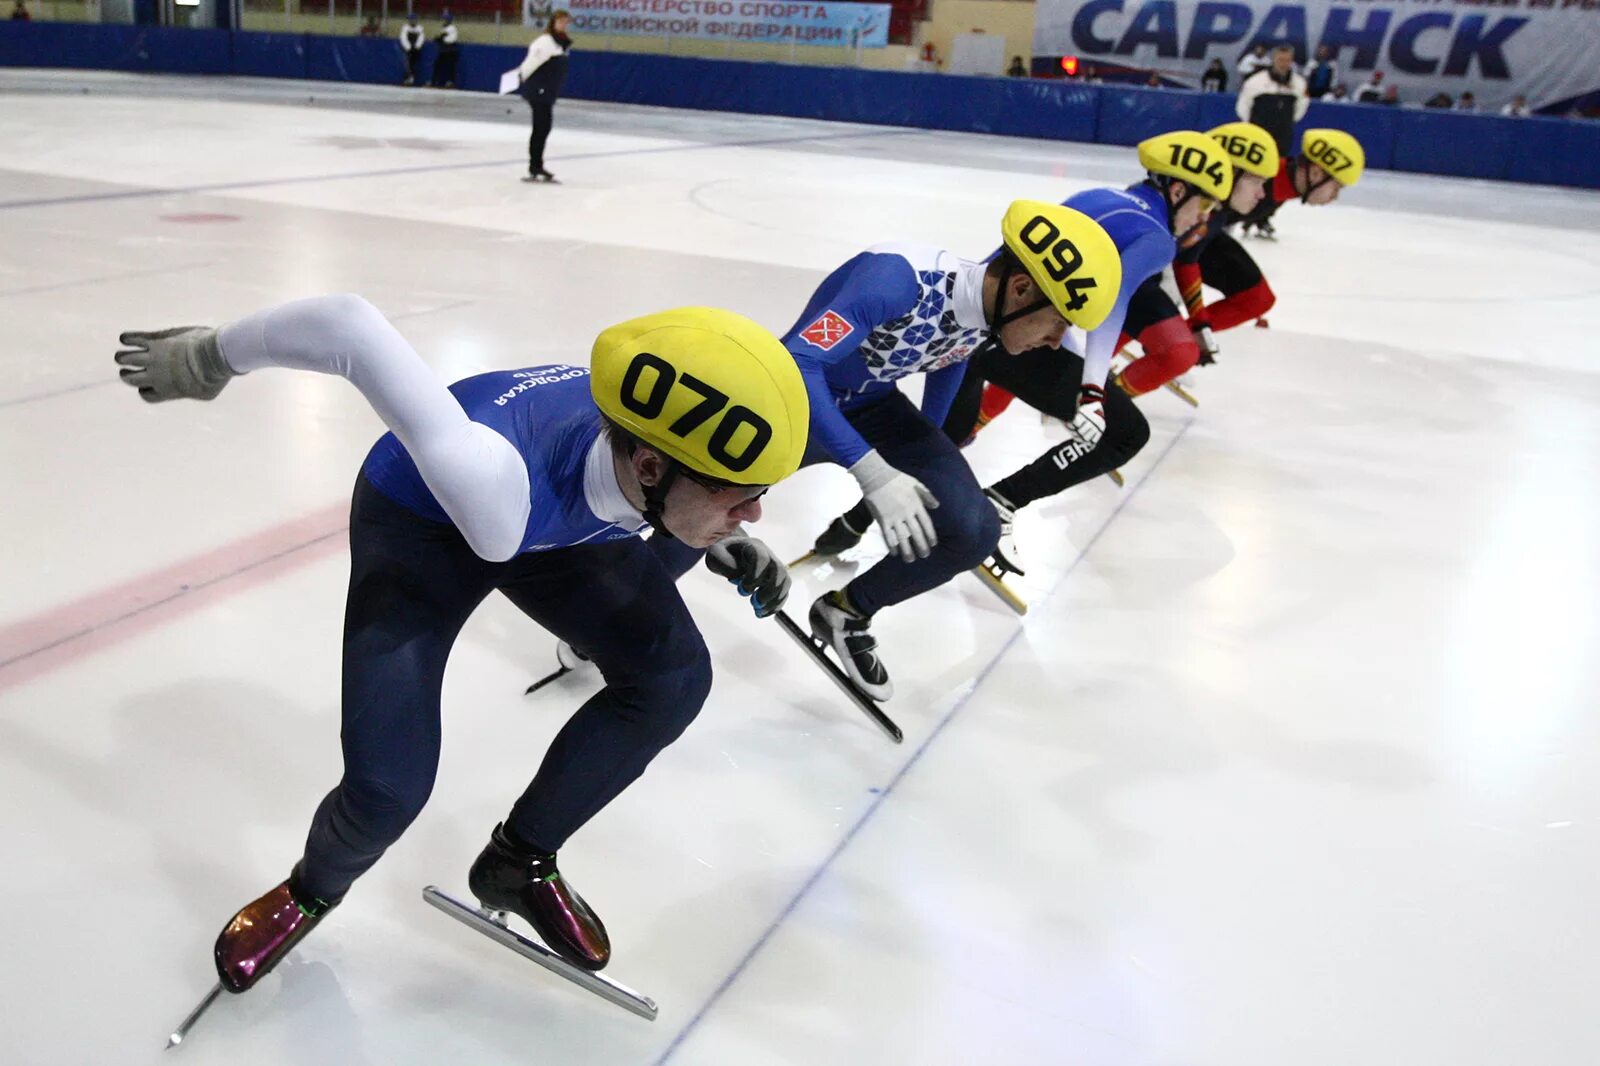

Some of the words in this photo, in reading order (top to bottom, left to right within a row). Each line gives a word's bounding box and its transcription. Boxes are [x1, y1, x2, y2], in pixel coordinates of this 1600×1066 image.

[572, 15, 699, 33] ОССИЙСКОЙ
[704, 22, 842, 41] ФЕДЕРАЦИИ
[739, 3, 828, 19] СПОРТА
[1072, 0, 1532, 81] САРАНСК
[1168, 143, 1225, 187] 104
[1309, 138, 1354, 173] 067
[1019, 215, 1098, 312] 094
[620, 352, 773, 473] 070
